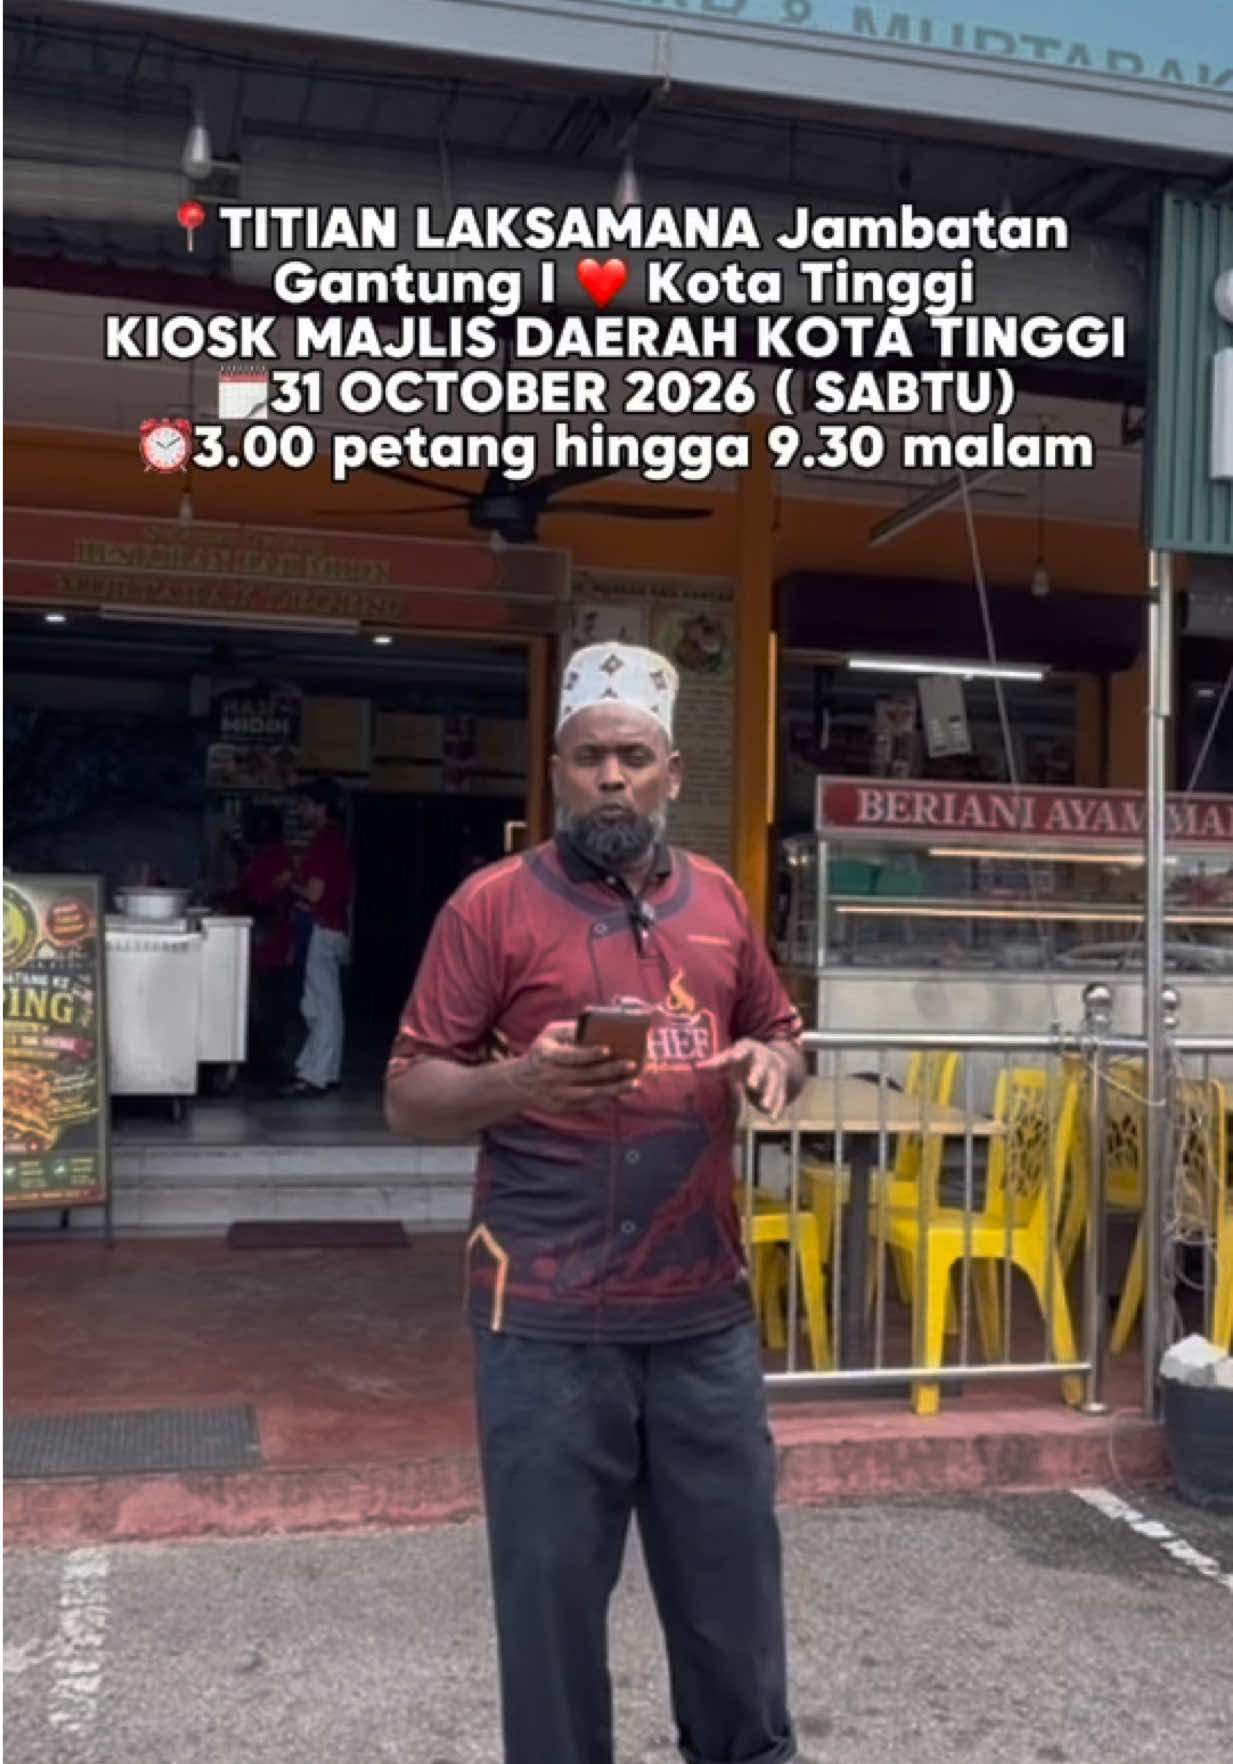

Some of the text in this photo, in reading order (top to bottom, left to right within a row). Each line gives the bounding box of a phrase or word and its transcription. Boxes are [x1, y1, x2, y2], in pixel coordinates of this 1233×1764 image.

[856, 788, 1233, 837] BERIANI AYAM MA
[3, 986, 74, 1025] ING
[646, 1027, 709, 1059] HEF
